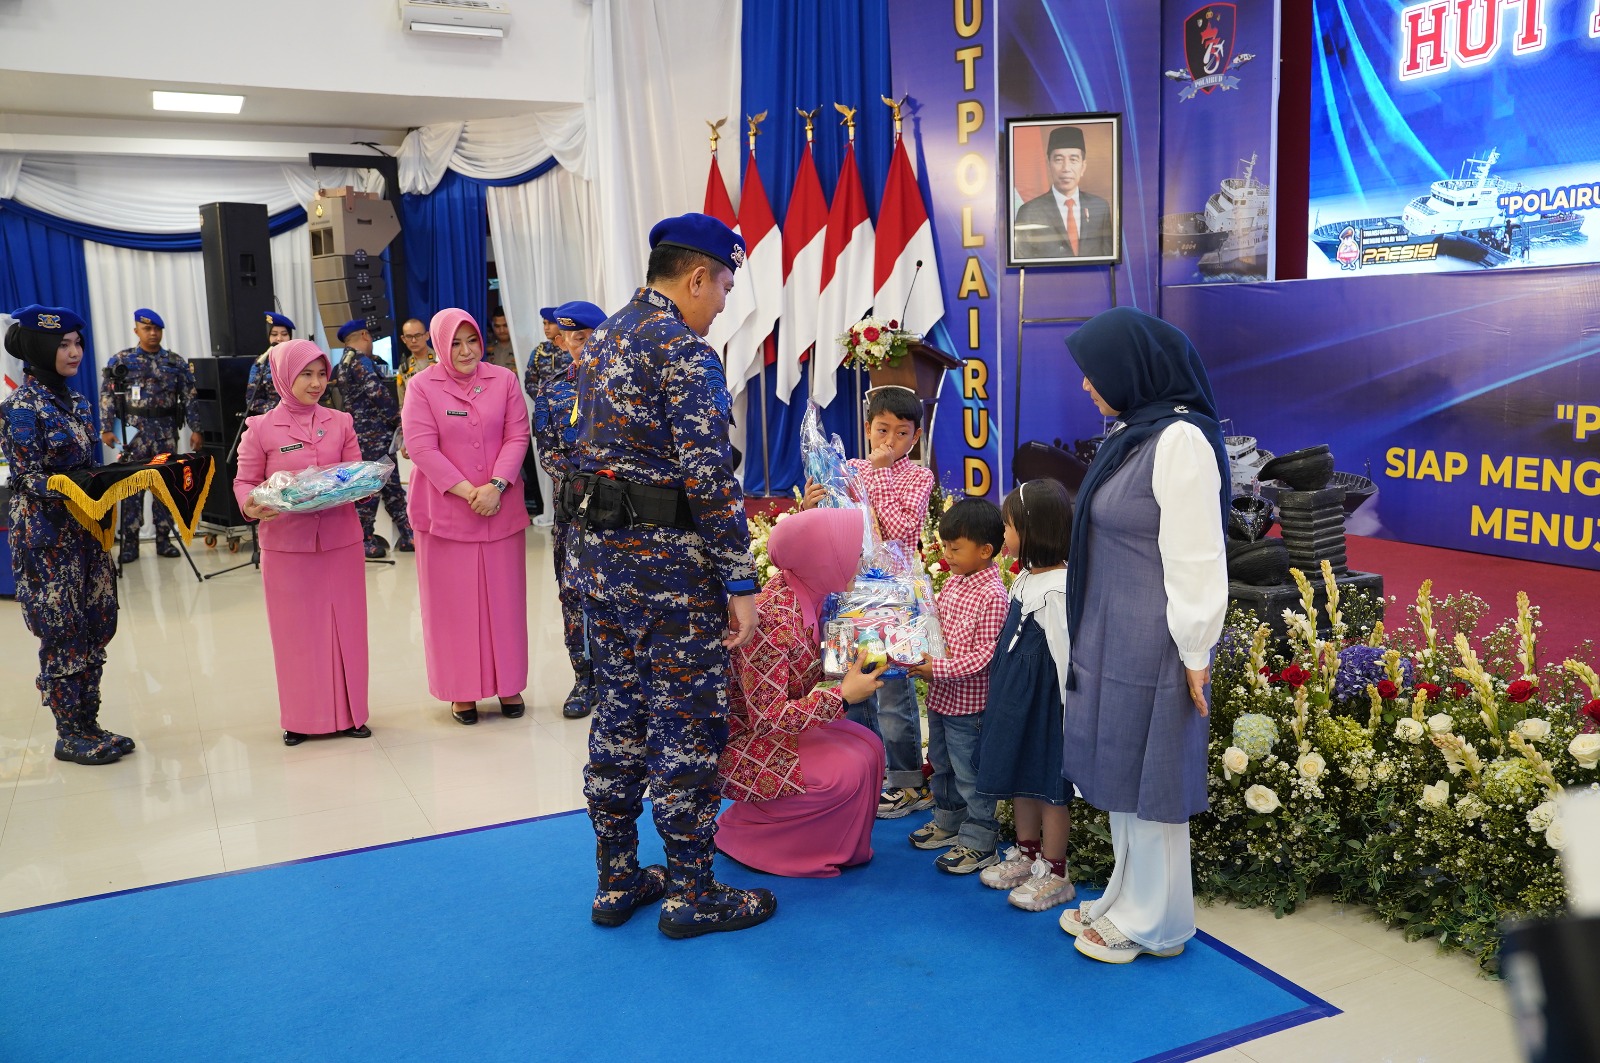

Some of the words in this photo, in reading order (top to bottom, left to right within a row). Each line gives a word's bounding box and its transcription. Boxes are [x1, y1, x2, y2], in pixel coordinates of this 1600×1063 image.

[1402, 0, 1545, 79] HUT
[1363, 243, 1438, 262] PRESISI
[1385, 447, 1468, 482] SIAP
[1480, 454, 1600, 496] MENG
